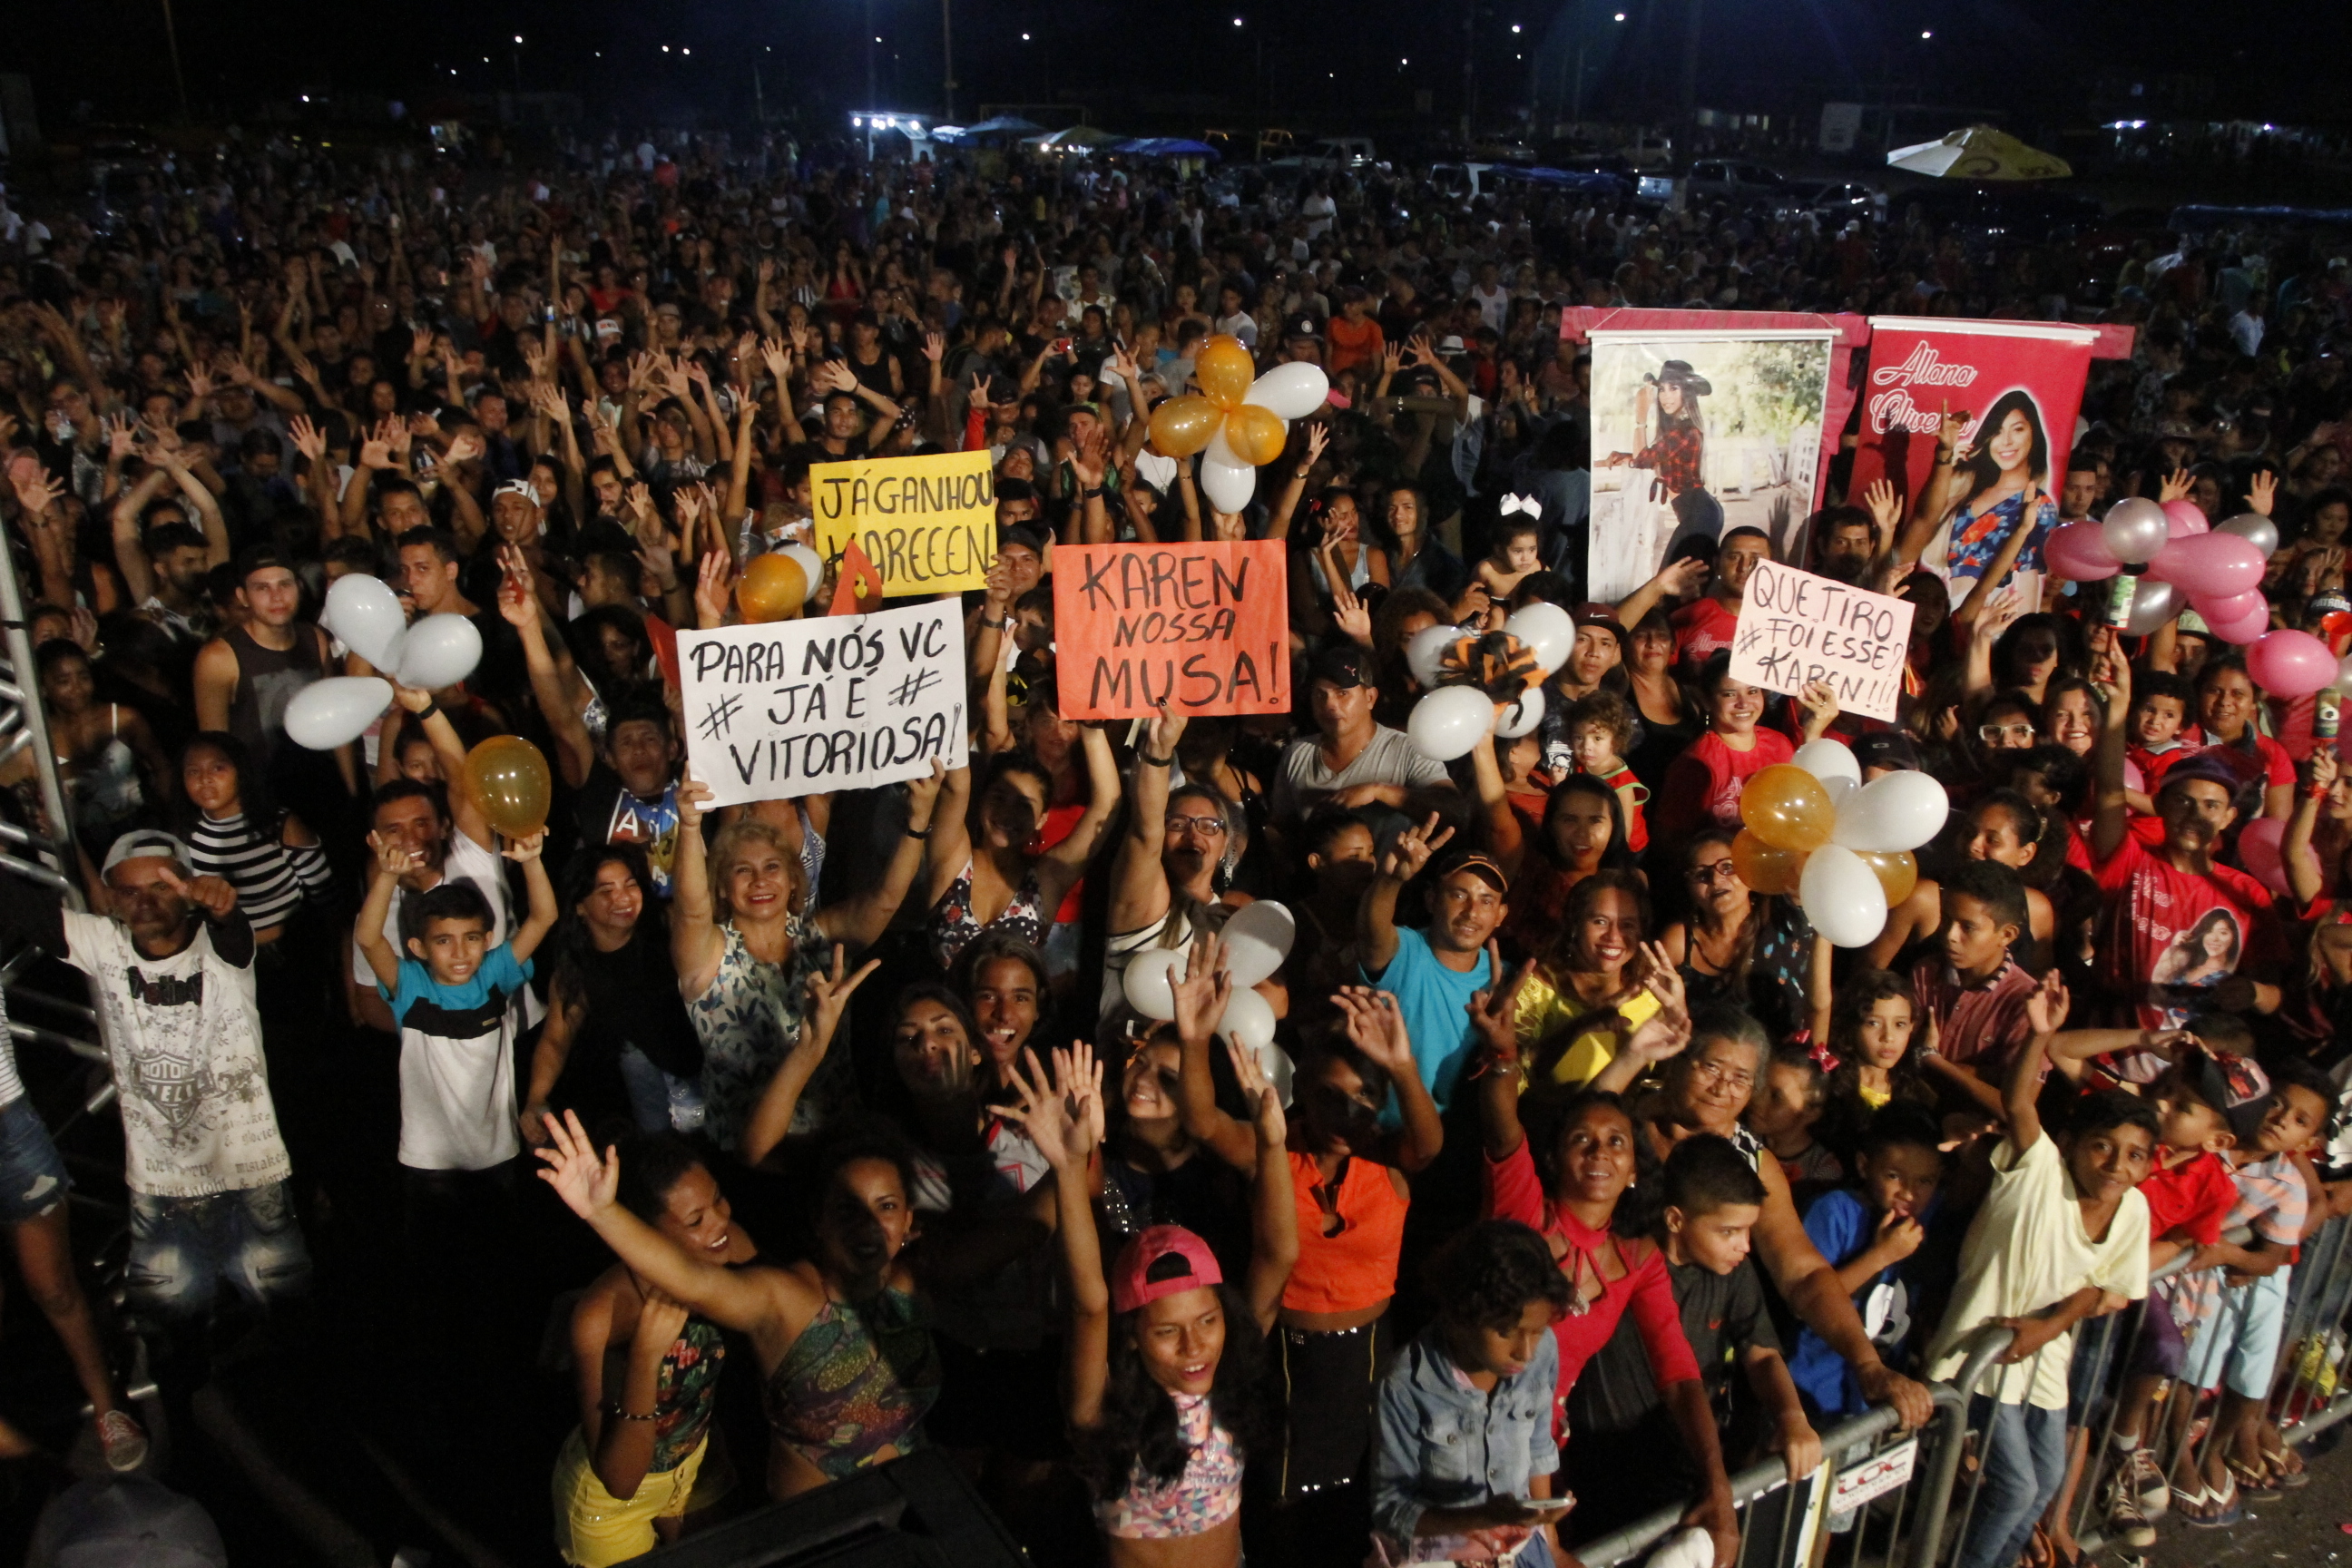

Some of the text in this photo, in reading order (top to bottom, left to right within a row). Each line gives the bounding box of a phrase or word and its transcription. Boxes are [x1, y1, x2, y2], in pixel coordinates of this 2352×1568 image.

[1873, 340, 1977, 387] Allana
[1079, 552, 1250, 611] KAREN
[1753, 565, 1894, 642] QUE TIRO
[689, 618, 946, 683] PARA NÓS VC
[1113, 608, 1236, 647] NOSSA
[1822, 631, 1904, 679] ESSE?
[768, 675, 834, 725] JÁ
[846, 667, 879, 720] É
[1089, 642, 1279, 710] MUSA!
[729, 702, 962, 785] VITORIOSA!
